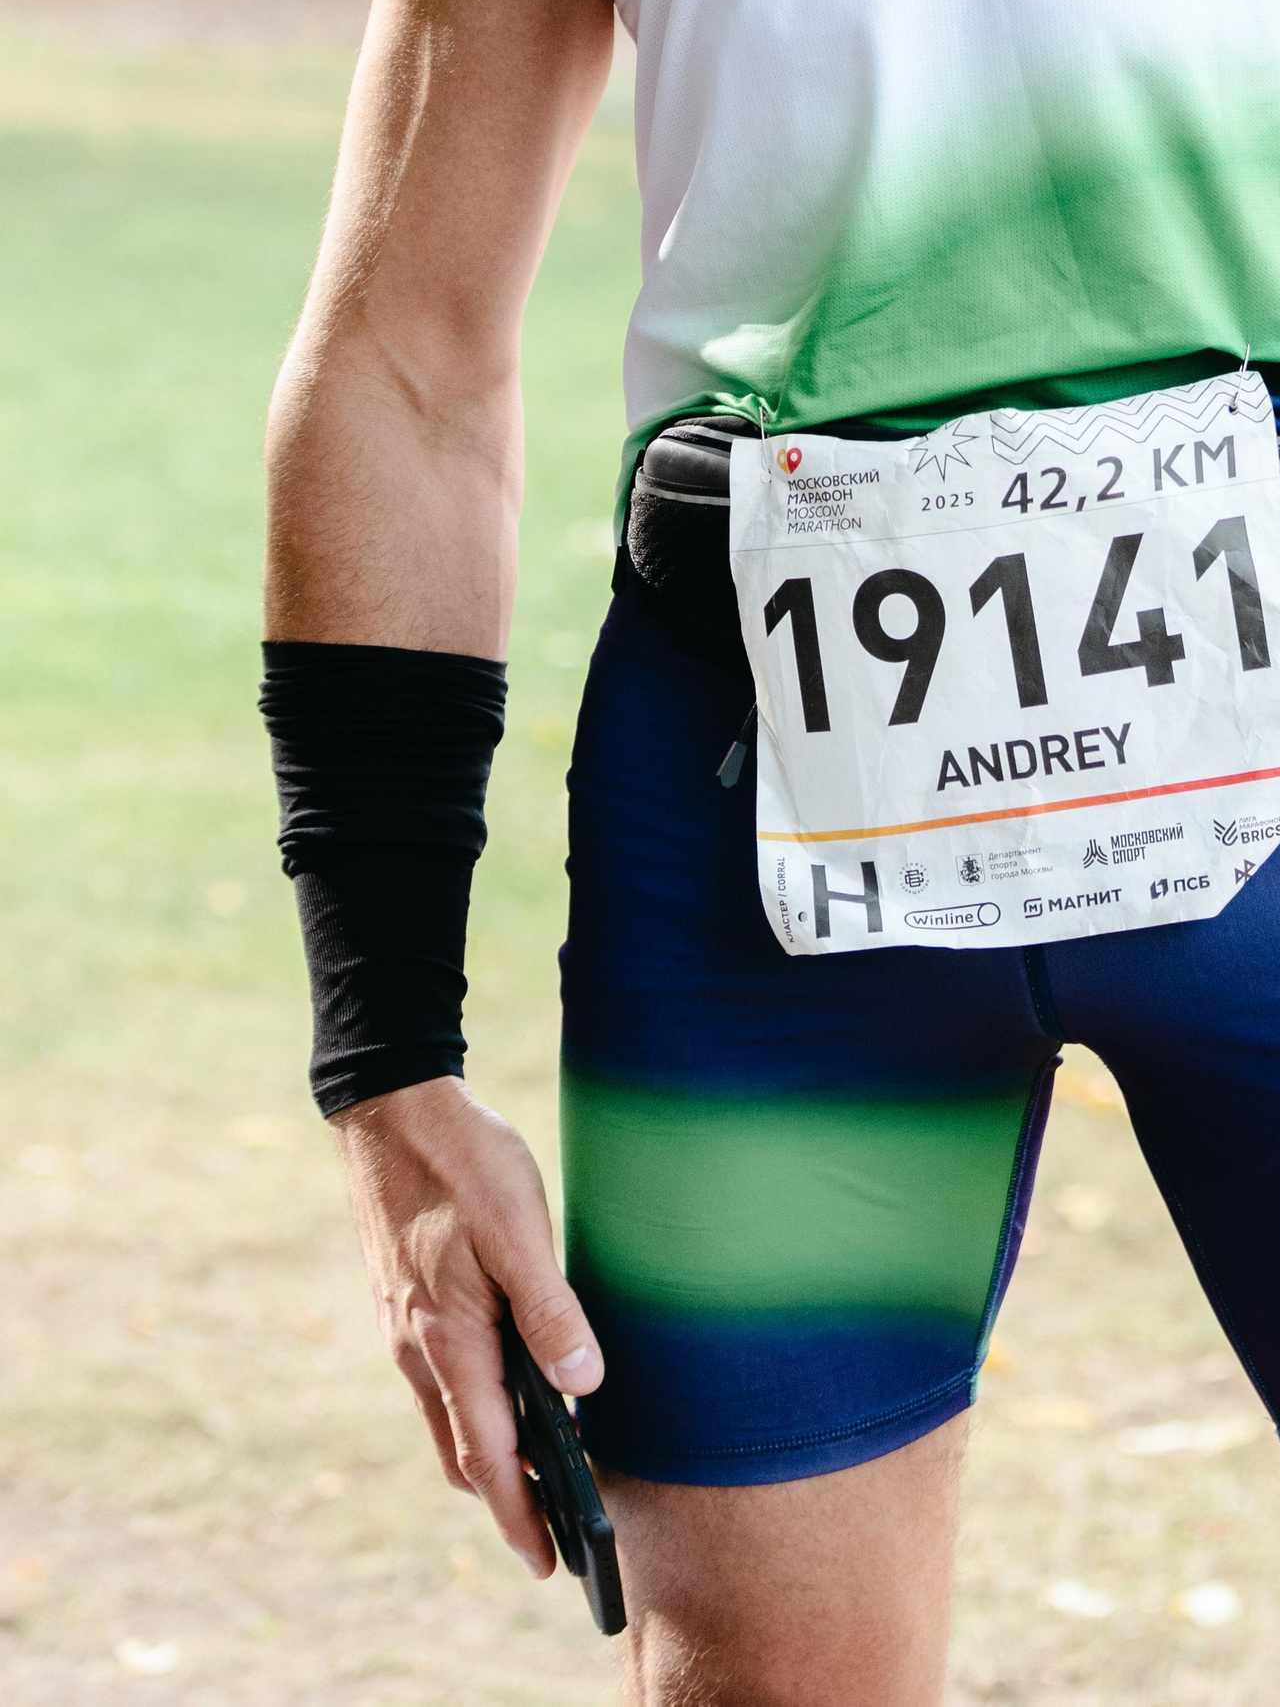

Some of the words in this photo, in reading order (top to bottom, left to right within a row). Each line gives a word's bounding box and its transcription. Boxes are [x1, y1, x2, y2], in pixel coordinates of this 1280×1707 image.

[787, 469, 880, 491] МОСКОВСКИЙ
[1001, 456, 1125, 514] 42,2
[787, 489, 853, 505] МАРАФОН
[921, 492, 975, 512] 2025
[787, 504, 846, 520] MOSCOW
[787, 517, 862, 534] MARATHON
[763, 515, 1272, 733] 19141
[936, 722, 1132, 792] ANDREY
[1110, 822, 1184, 850] МОСКОВСКИЙ
[988, 847, 1042, 861] Департамент
[1112, 846, 1147, 865] СПОРТ
[777, 857, 786, 892] CORRAL
[989, 860, 1018, 871] спорта
[990, 870, 1019, 881] города
[1021, 865, 1054, 876] Москвы
[1173, 875, 1211, 894] ПСБ
[1048, 888, 1123, 912] МАГНИТ
[778, 900, 795, 943] КЛАСТЕР
[913, 910, 974, 926] Winline
